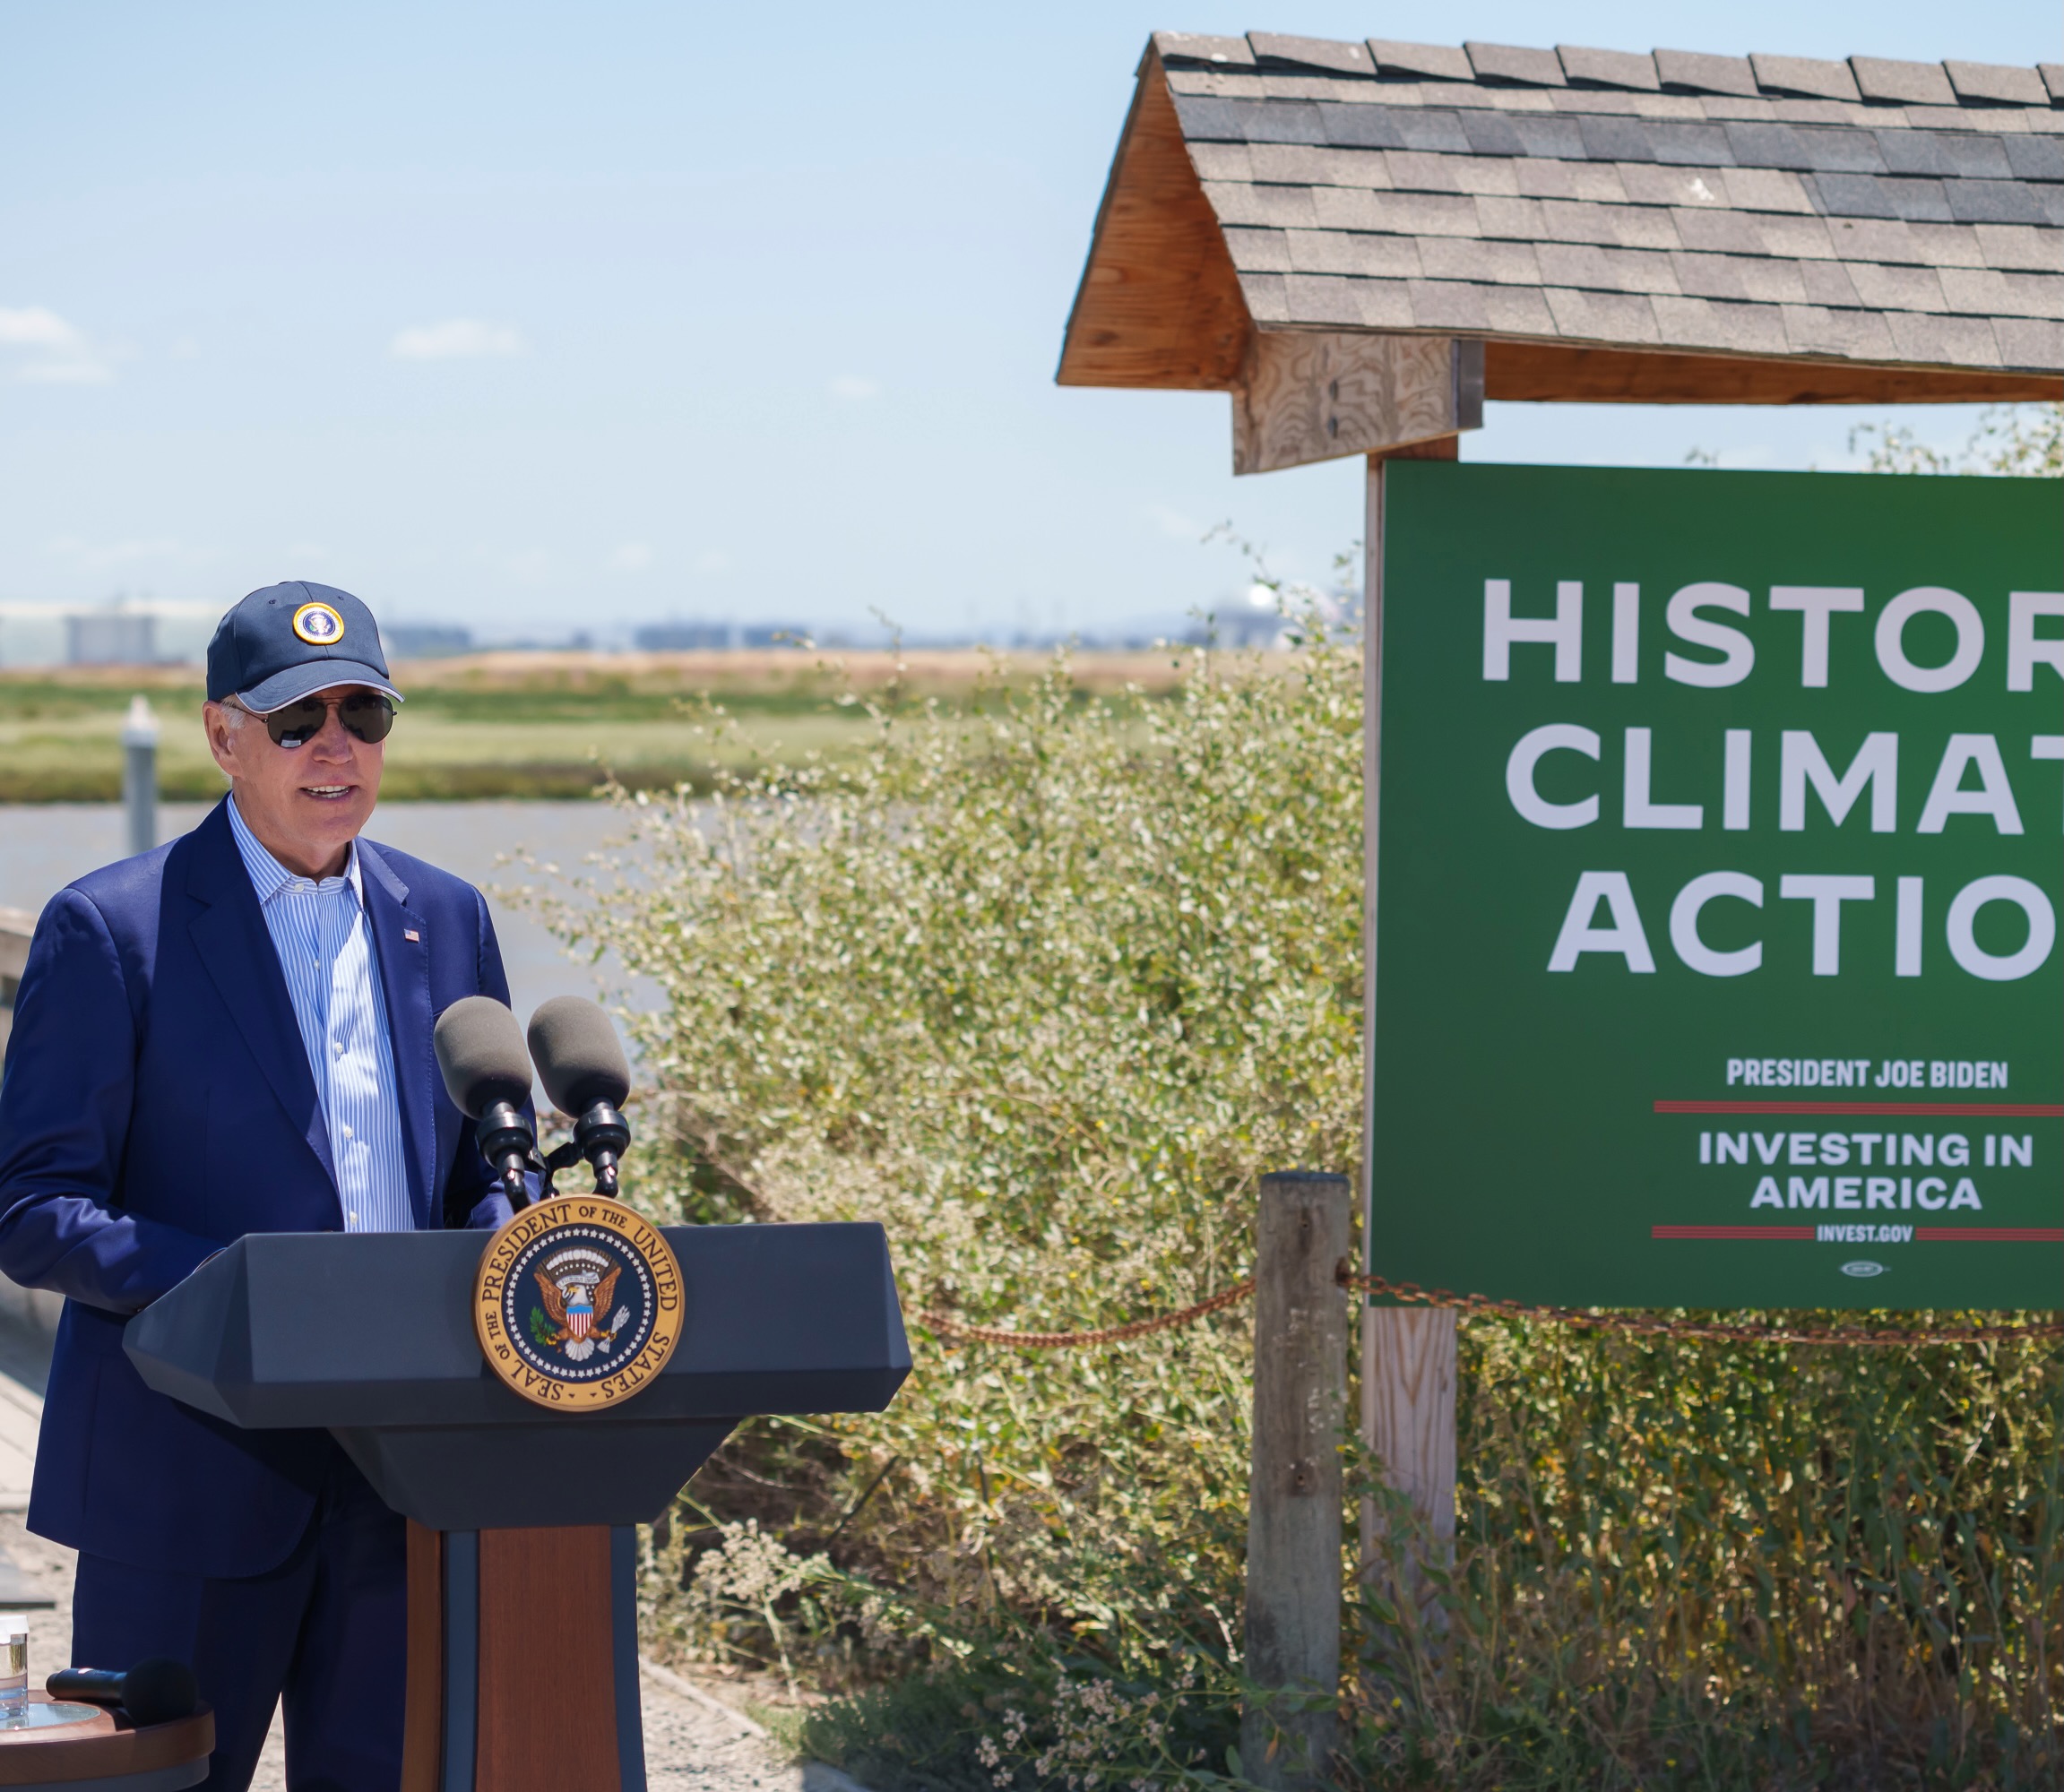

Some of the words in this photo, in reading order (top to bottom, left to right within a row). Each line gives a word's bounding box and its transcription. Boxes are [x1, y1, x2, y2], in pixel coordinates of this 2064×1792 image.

[1726, 1059, 1870, 1087] PRESIDENT
[1875, 1061, 1924, 1088] JOE
[1930, 1062, 2008, 1089] BIDEN
[1700, 1132, 1969, 1167] INVESTING
[1984, 1134, 2033, 1167] IN
[1749, 1176, 1982, 1210] AMERICA
[578, 1205, 598, 1219] OF
[601, 1209, 628, 1229] THE
[1818, 1225, 1913, 1243] INVEST.GOV
[481, 1203, 571, 1303] PRESIDENT
[633, 1225, 678, 1312] UNITED
[485, 1311, 501, 1340] THE
[494, 1342, 510, 1360] OF
[600, 1331, 670, 1399] STATES
[511, 1359, 564, 1401] SEAL
